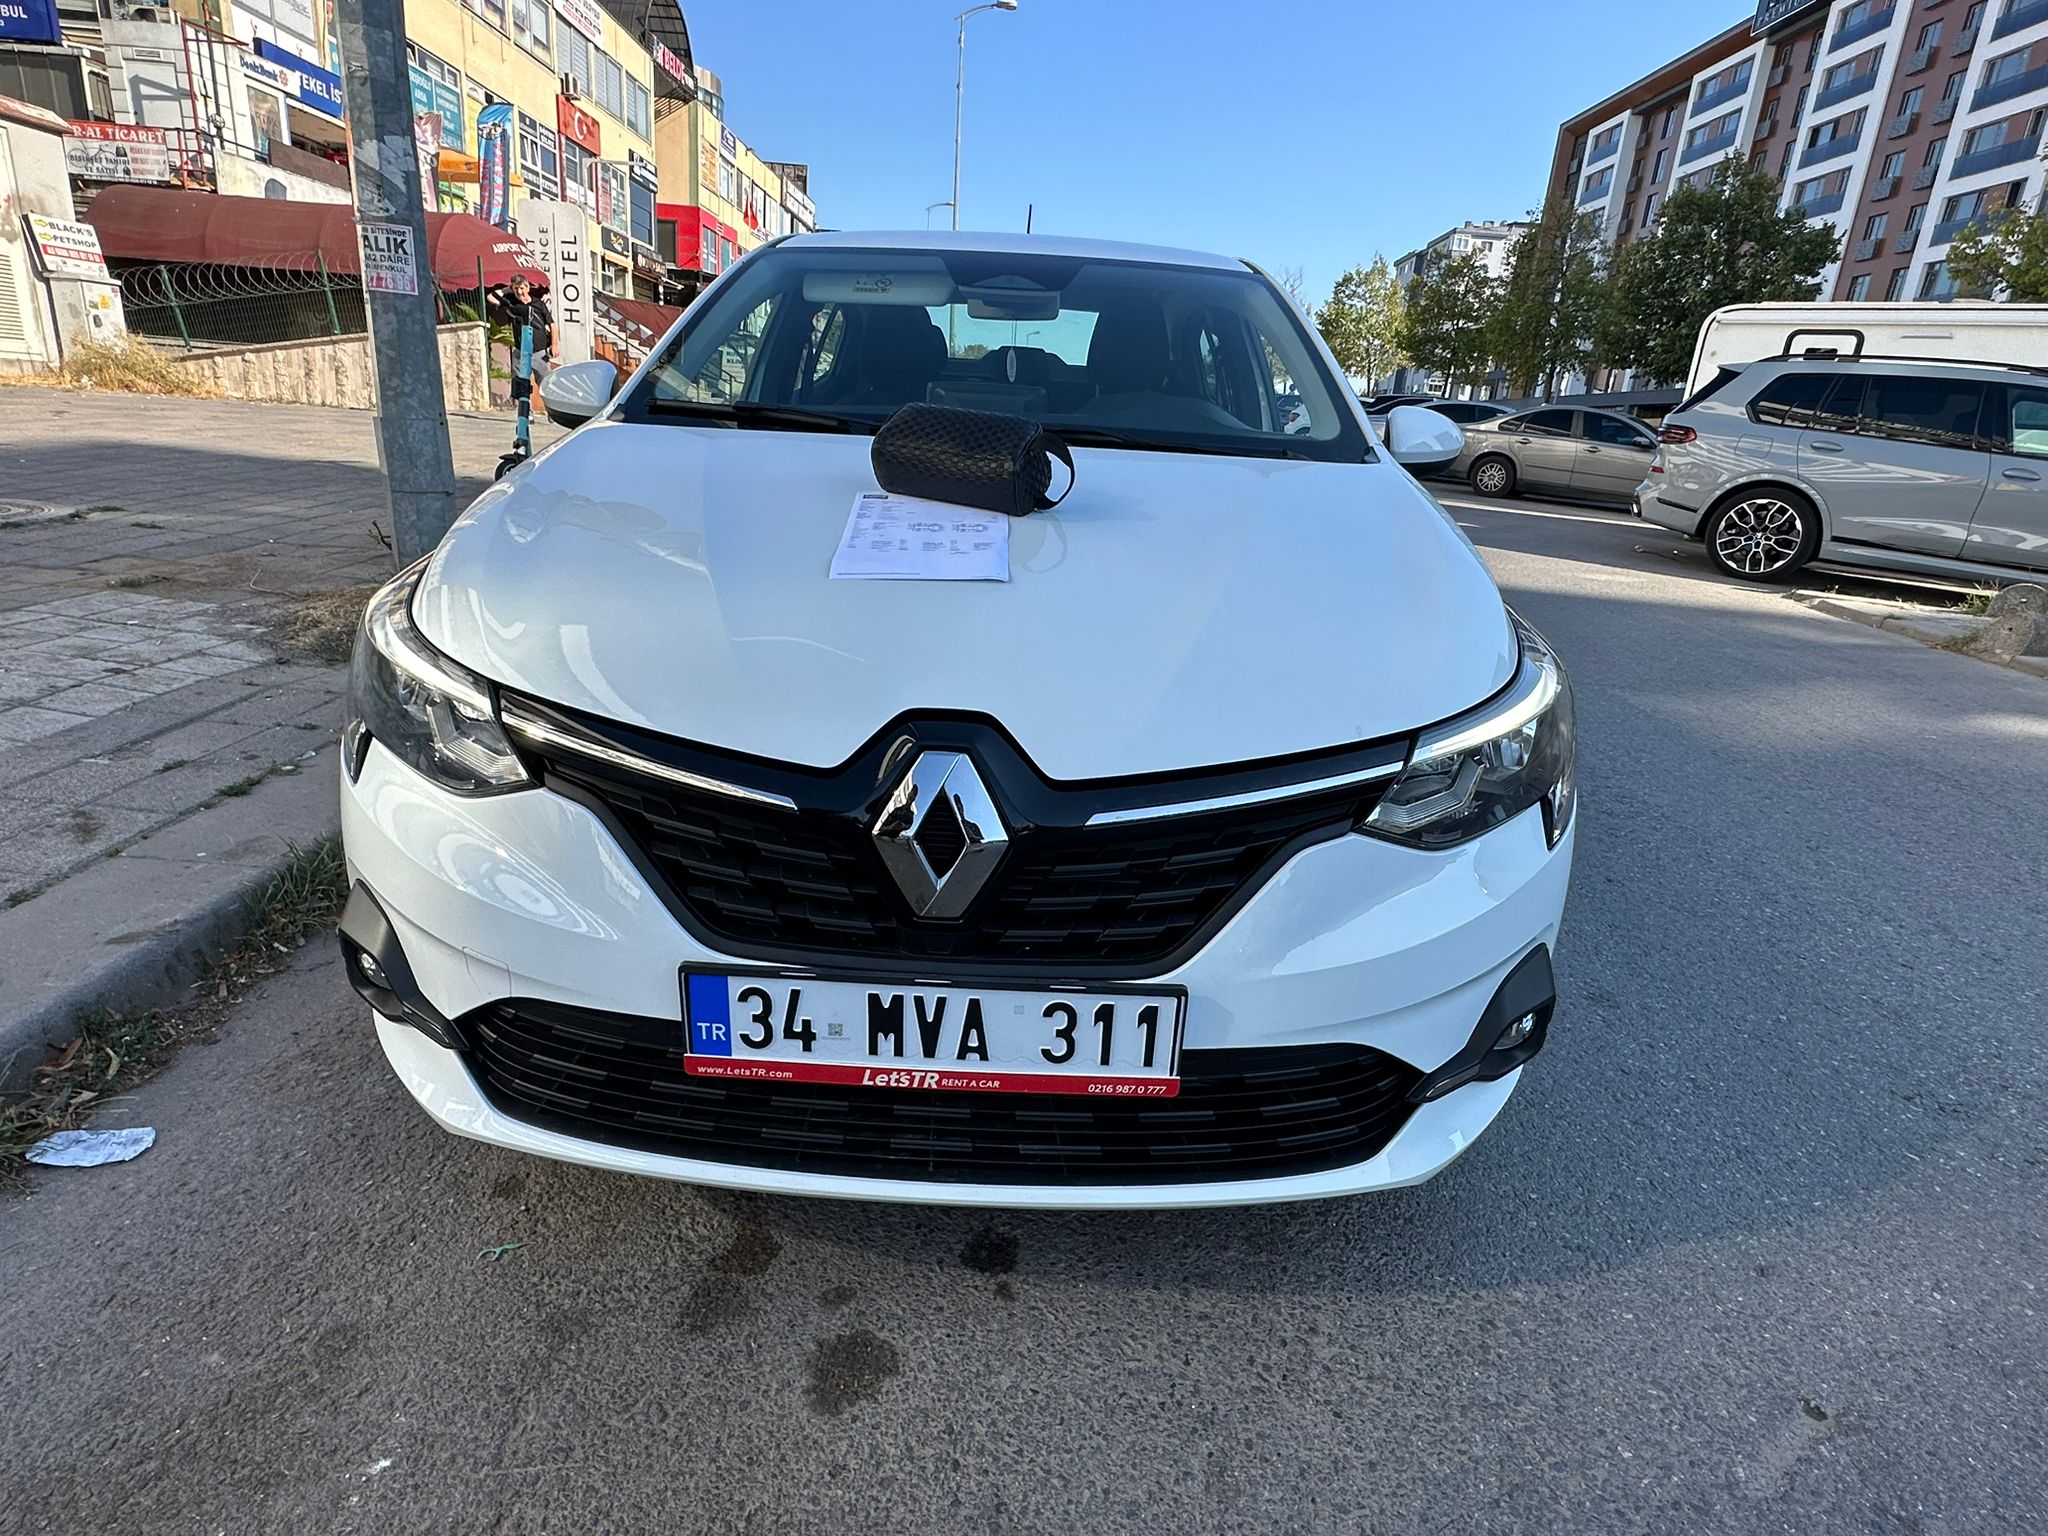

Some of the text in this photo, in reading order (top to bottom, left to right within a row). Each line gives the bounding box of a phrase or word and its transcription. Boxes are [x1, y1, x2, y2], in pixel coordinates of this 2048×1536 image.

[239, 54, 278, 82] DenizBank
[300, 73, 343, 104] EKEL İS
[72, 125, 165, 144] R-AL TİCARET
[48, 221, 94, 237] BLACK'S
[52, 234, 97, 248] PETSHOP
[380, 254, 411, 266] DAİRE
[560, 235, 580, 323] HOTEL
[697, 1022, 726, 1041] TR
[737, 986, 1160, 1068] 34 MVA 311
[697, 1065, 793, 1079] www.LetsTR.com
[941, 1079, 968, 1088] RENT
[969, 1079, 978, 1088] A
[979, 1079, 1001, 1089] CAR
[1088, 1084, 1167, 1095] 0216 987 0 777
